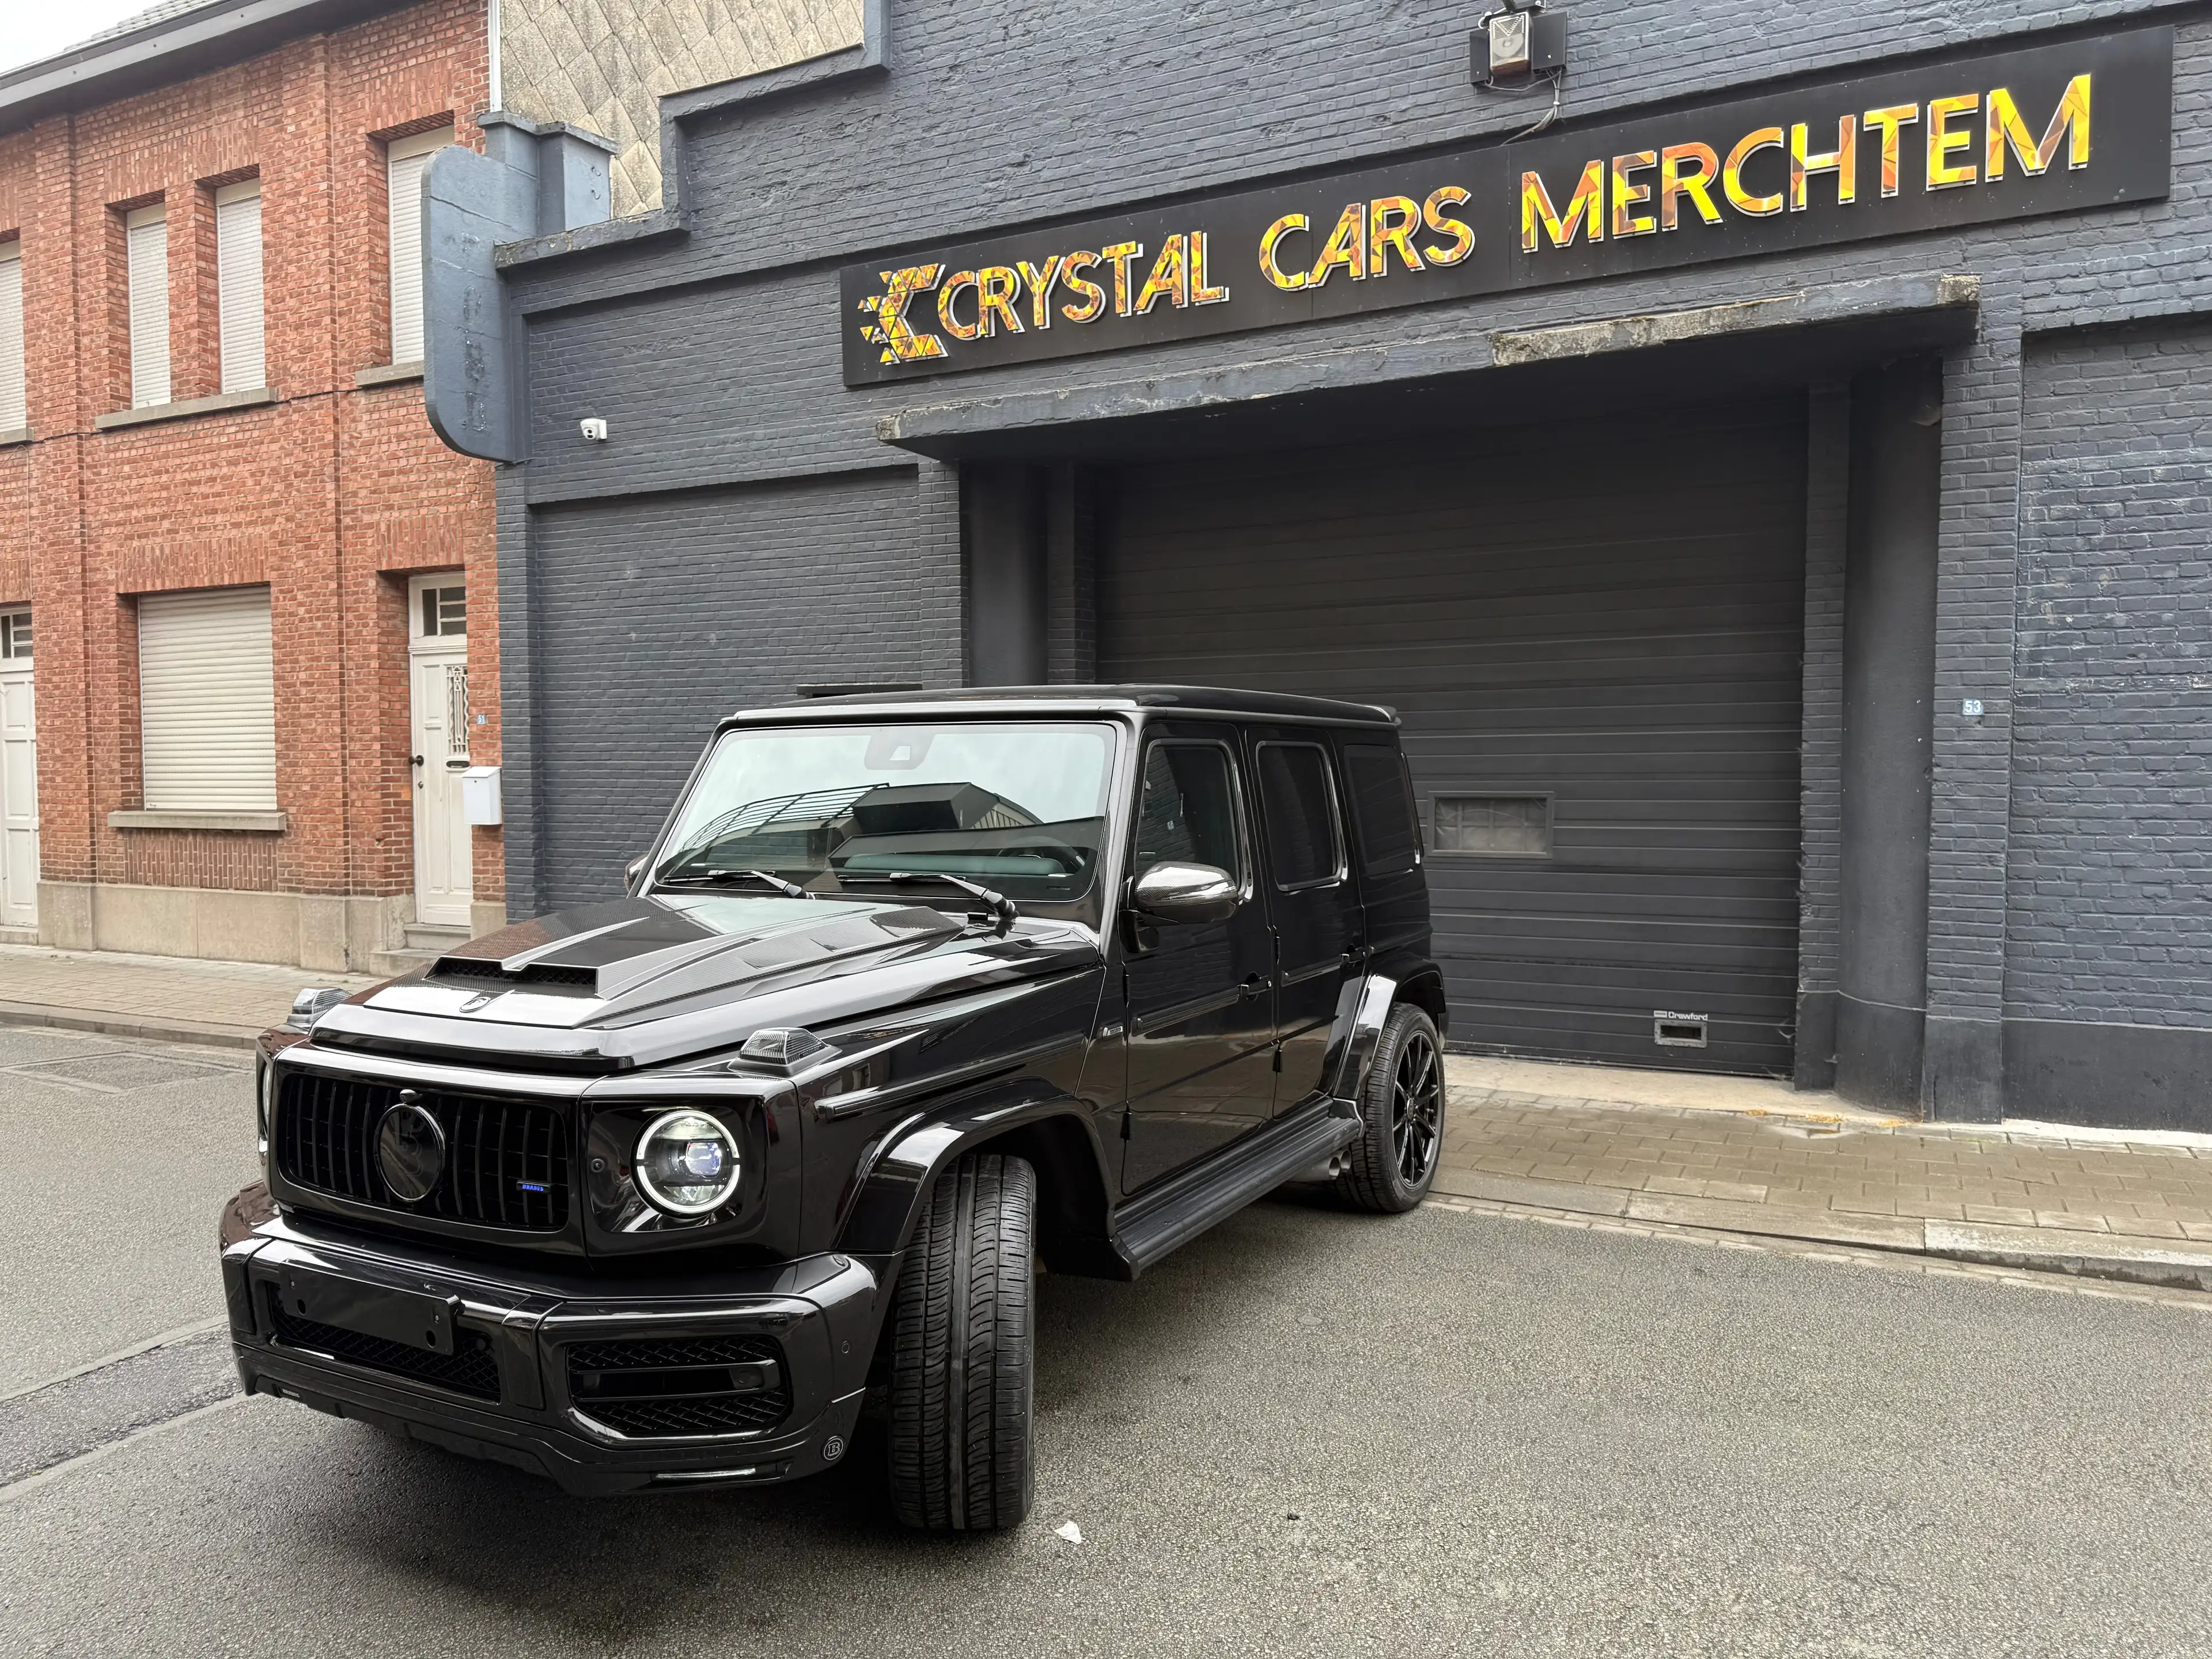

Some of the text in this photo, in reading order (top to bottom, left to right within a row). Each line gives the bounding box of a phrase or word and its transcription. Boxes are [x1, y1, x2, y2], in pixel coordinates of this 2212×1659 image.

[938, 230, 1230, 341] CRYSTAL
[1259, 185, 1476, 292] CARS
[1521, 74, 2092, 253] MERCHTEM
[1965, 699, 1981, 713] 53
[1668, 1011, 1708, 1021] Crawford
[522, 1184, 544, 1192] BRABUS
